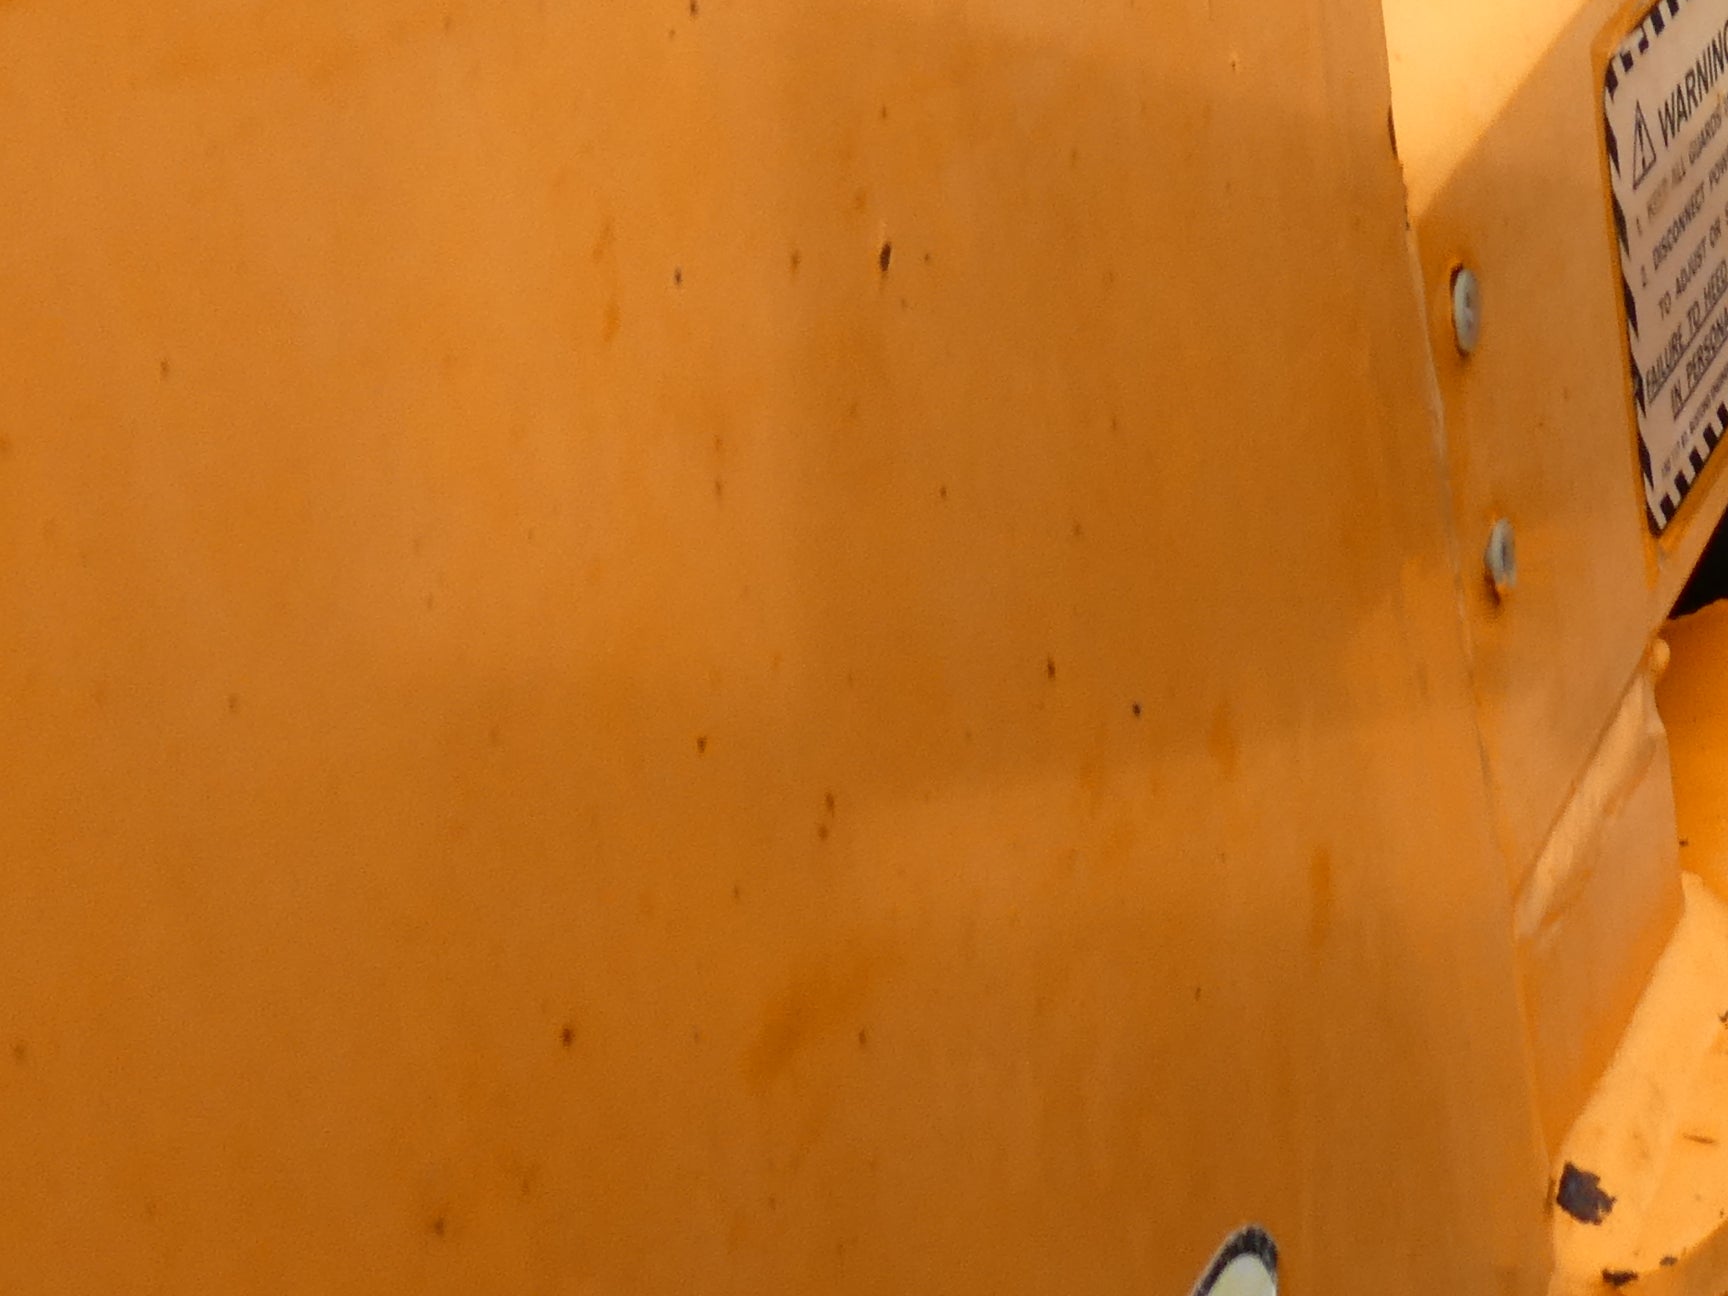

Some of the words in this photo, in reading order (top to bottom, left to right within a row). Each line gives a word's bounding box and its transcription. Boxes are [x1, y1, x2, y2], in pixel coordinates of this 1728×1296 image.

[1669, 155, 1686, 190] ALL
[1687, 106, 1722, 166] GUARDS
[1651, 181, 1706, 271] DISCONNECT
[1657, 288, 1672, 321] TO
[1674, 238, 1708, 299] ADJUST
[1708, 217, 1722, 248] OR
[1644, 324, 1685, 404] FAILURE
[1686, 300, 1702, 338] TO
[1702, 258, 1728, 315] HEED
[1669, 378, 1684, 419] IN
